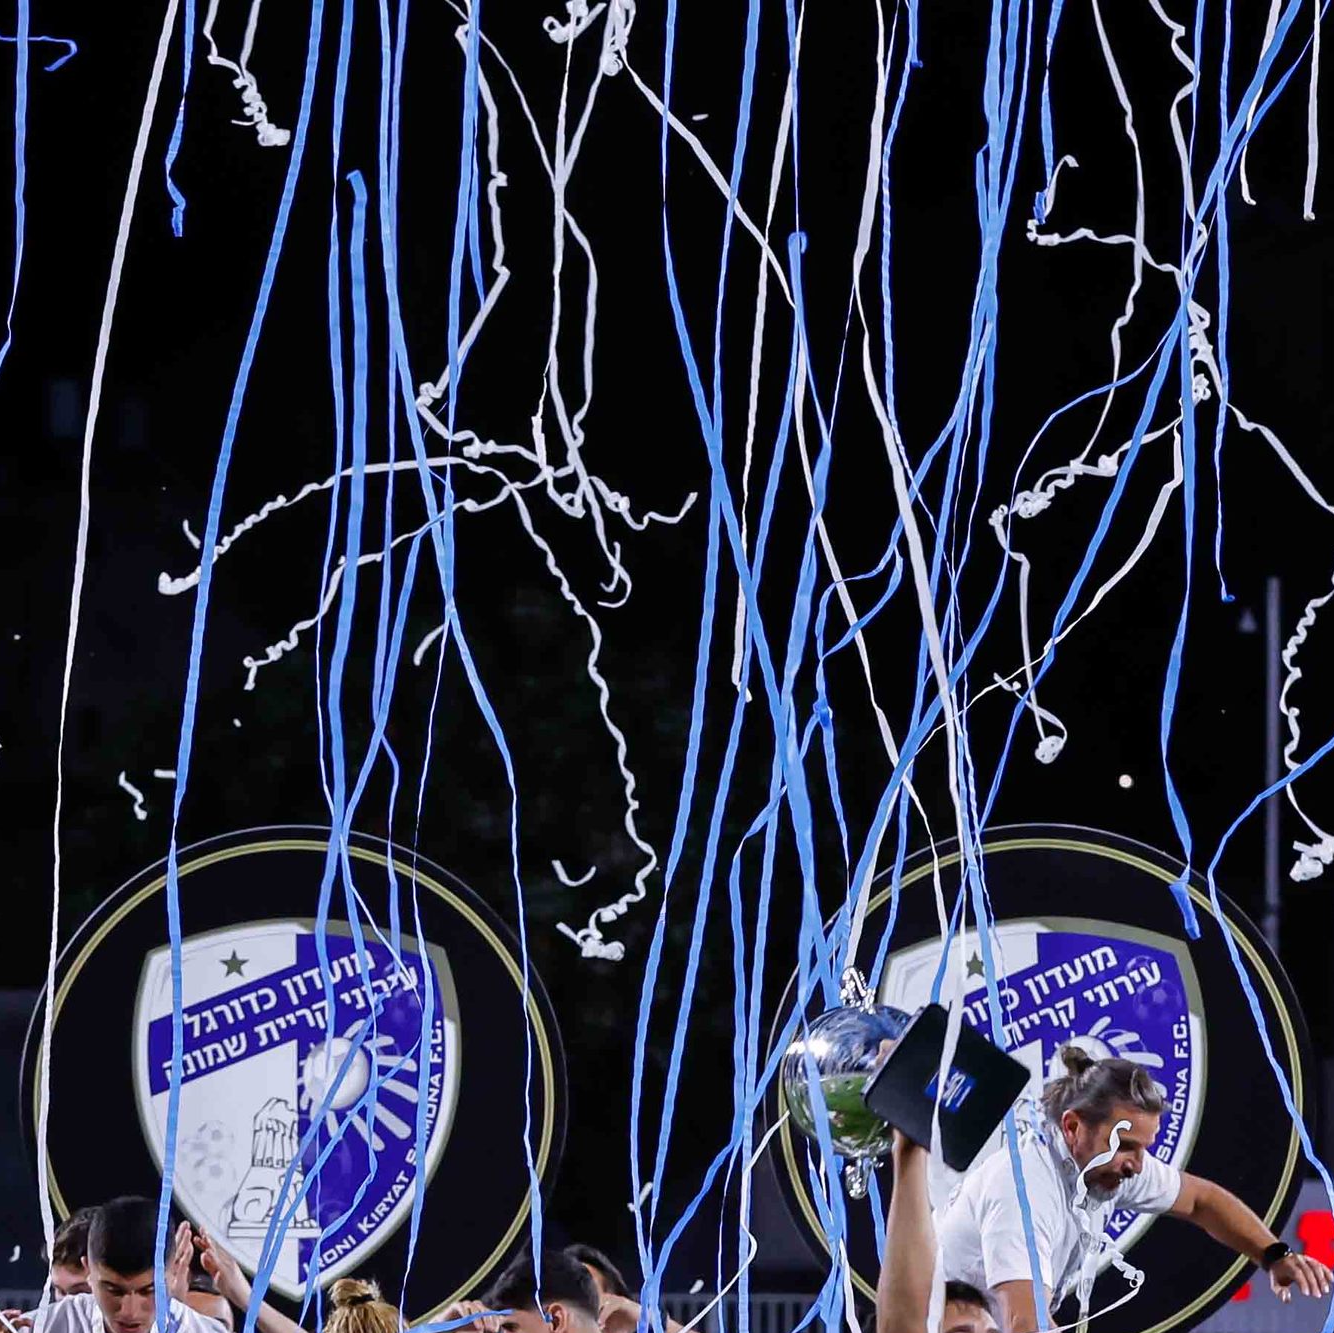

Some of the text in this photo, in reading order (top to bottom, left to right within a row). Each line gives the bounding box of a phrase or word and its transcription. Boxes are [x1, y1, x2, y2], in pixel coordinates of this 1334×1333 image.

[1023, 945, 1118, 1005] מועדון
[1083, 961, 1162, 1008] עירוני
[183, 988, 277, 1038] כדורגל
[255, 1000, 331, 1047] קריית
[1156, 1015, 1190, 1165] SHMONA F.C.
[357, 1171, 410, 1236] KIRYAT
[405, 1073, 442, 1167] SMONA
